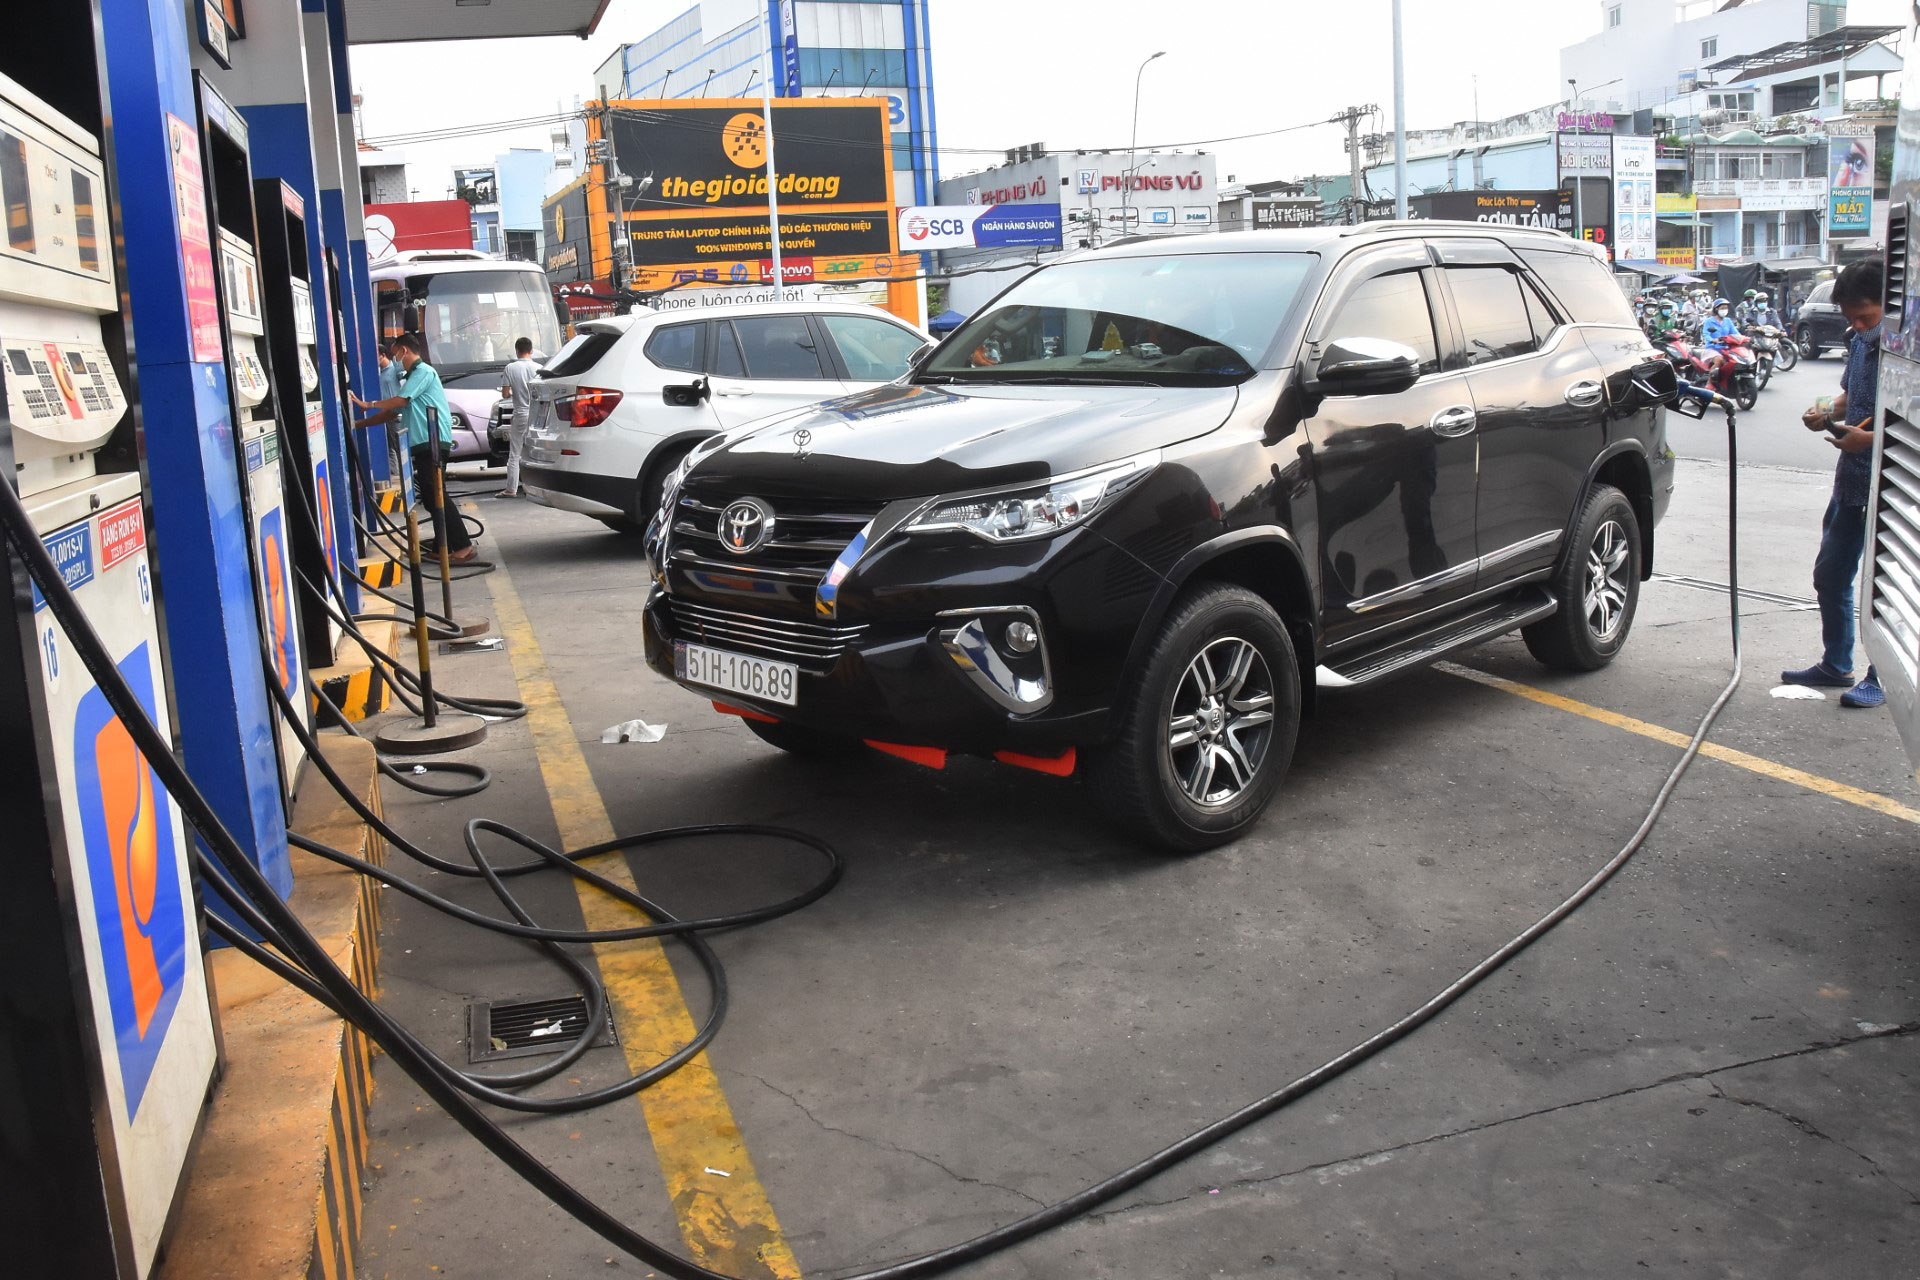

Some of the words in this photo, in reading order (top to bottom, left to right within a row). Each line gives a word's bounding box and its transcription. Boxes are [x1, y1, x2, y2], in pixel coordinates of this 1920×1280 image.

[662, 173, 840, 203] thegioididong
[1102, 175, 1174, 191] PHONG
[981, 183, 1026, 205] PHONG
[632, 230, 664, 241] TRUNG
[665, 228, 684, 239] TÂM
[686, 228, 721, 238] LAPTOP
[722, 225, 751, 236] CHÍNH
[753, 225, 773, 235] HÃN
[795, 223, 812, 233] CÁC
[851, 220, 872, 232] HIỆU
[930, 219, 964, 235] SCB
[982, 221, 1003, 231] NGÂN
[1004, 221, 1025, 230] HÀNG
[1026, 220, 1038, 230] SÀI
[1039, 219, 1055, 229] GÒN
[766, 242, 784, 250] BN
[824, 261, 864, 275] acer
[701, 293, 732, 307] luôn
[735, 291, 753, 304] có
[118, 517, 130, 540] RON
[137, 564, 150, 604] 15
[43, 627, 59, 682] 16
[689, 647, 793, 701] 51H-106.89
